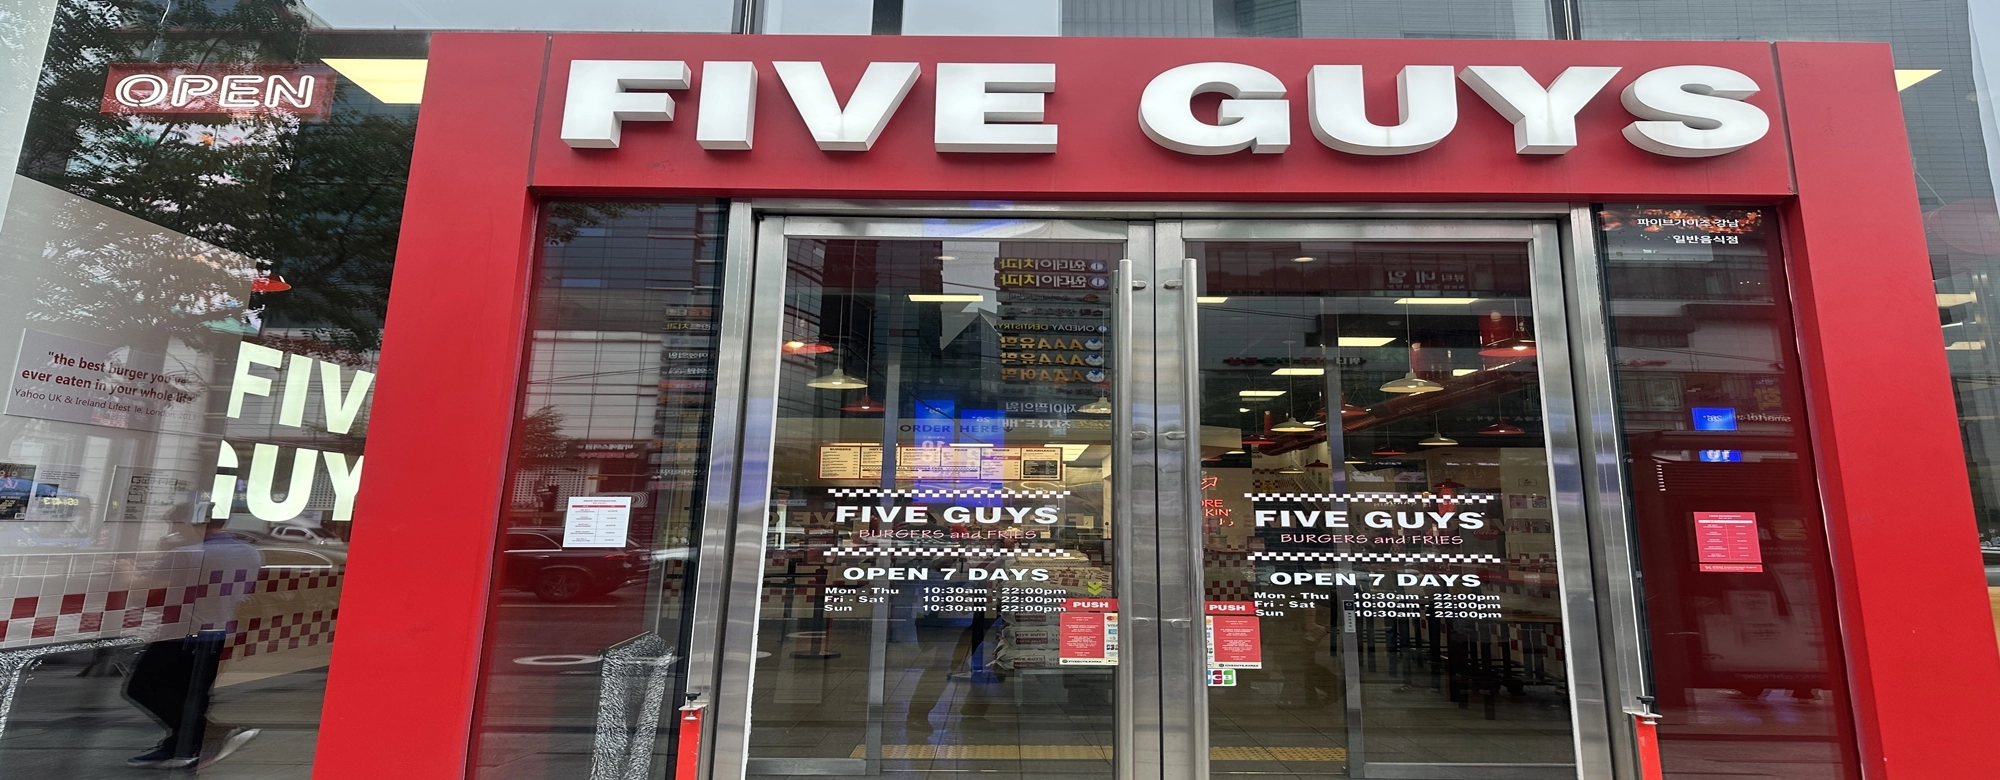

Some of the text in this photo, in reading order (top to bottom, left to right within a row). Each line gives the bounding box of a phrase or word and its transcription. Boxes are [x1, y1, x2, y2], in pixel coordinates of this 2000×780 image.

[115, 74, 315, 109] OPEN
[560, 59, 1770, 158] FIVE GUYS
[1637, 218, 1740, 228] 파이브가이즈 강남
[1673, 235, 1739, 244] 일반음식점
[48, 351, 75, 366] "the
[78, 356, 105, 373] best
[109, 362, 148, 381] burger
[21, 369, 52, 383] ever
[55, 374, 91, 389] eaten
[95, 378, 106, 391] in
[109, 383, 138, 399] your
[140, 387, 173, 402] whole
[226, 341, 375, 434] FIV
[14, 388, 46, 400] Yahoo
[48, 393, 62, 403] UK
[64, 395, 73, 404] &
[75, 397, 106, 409] Ireland
[108, 402, 144, 414] Lifestle,
[900, 424, 999, 433] ORDER HERE
[836, 506, 928, 523] FIVE
[943, 506, 1058, 524] GUYS
[1254, 510, 1349, 528] FIVE
[1364, 510, 1484, 529] GUYS
[859, 529, 1037, 539] BURGERS and FRIES
[1281, 534, 1464, 545] BURGERS and FRIES
[843, 568, 1050, 581] OPEN 7 DAYS
[1270, 572, 1482, 587] OPEN 7 DAYS
[825, 587, 856, 595] Mon
[871, 587, 899, 595] Thu
[922, 587, 987, 595] 10:30am
[1001, 587, 1067, 596] 22:00pm
[1254, 592, 1287, 600] Mon
[1301, 592, 1329, 600] Thu
[1353, 592, 1418, 600] 10:30am
[1433, 593, 1501, 602] 22:00pm
[1001, 596, 1067, 604] 22:00pm
[1254, 600, 1279, 608] Fri
[1289, 600, 1316, 609] Sat
[1353, 601, 1419, 609] 10:00am
[1434, 601, 1501, 611] 22:00pm
[824, 604, 853, 612] Sun
[922, 604, 987, 612] 10:30am
[1001, 604, 1067, 613] 22:00pm
[1255, 609, 1285, 617] Sun
[1354, 610, 1420, 618] 10:30am
[1434, 610, 1502, 620] 22:00pm
